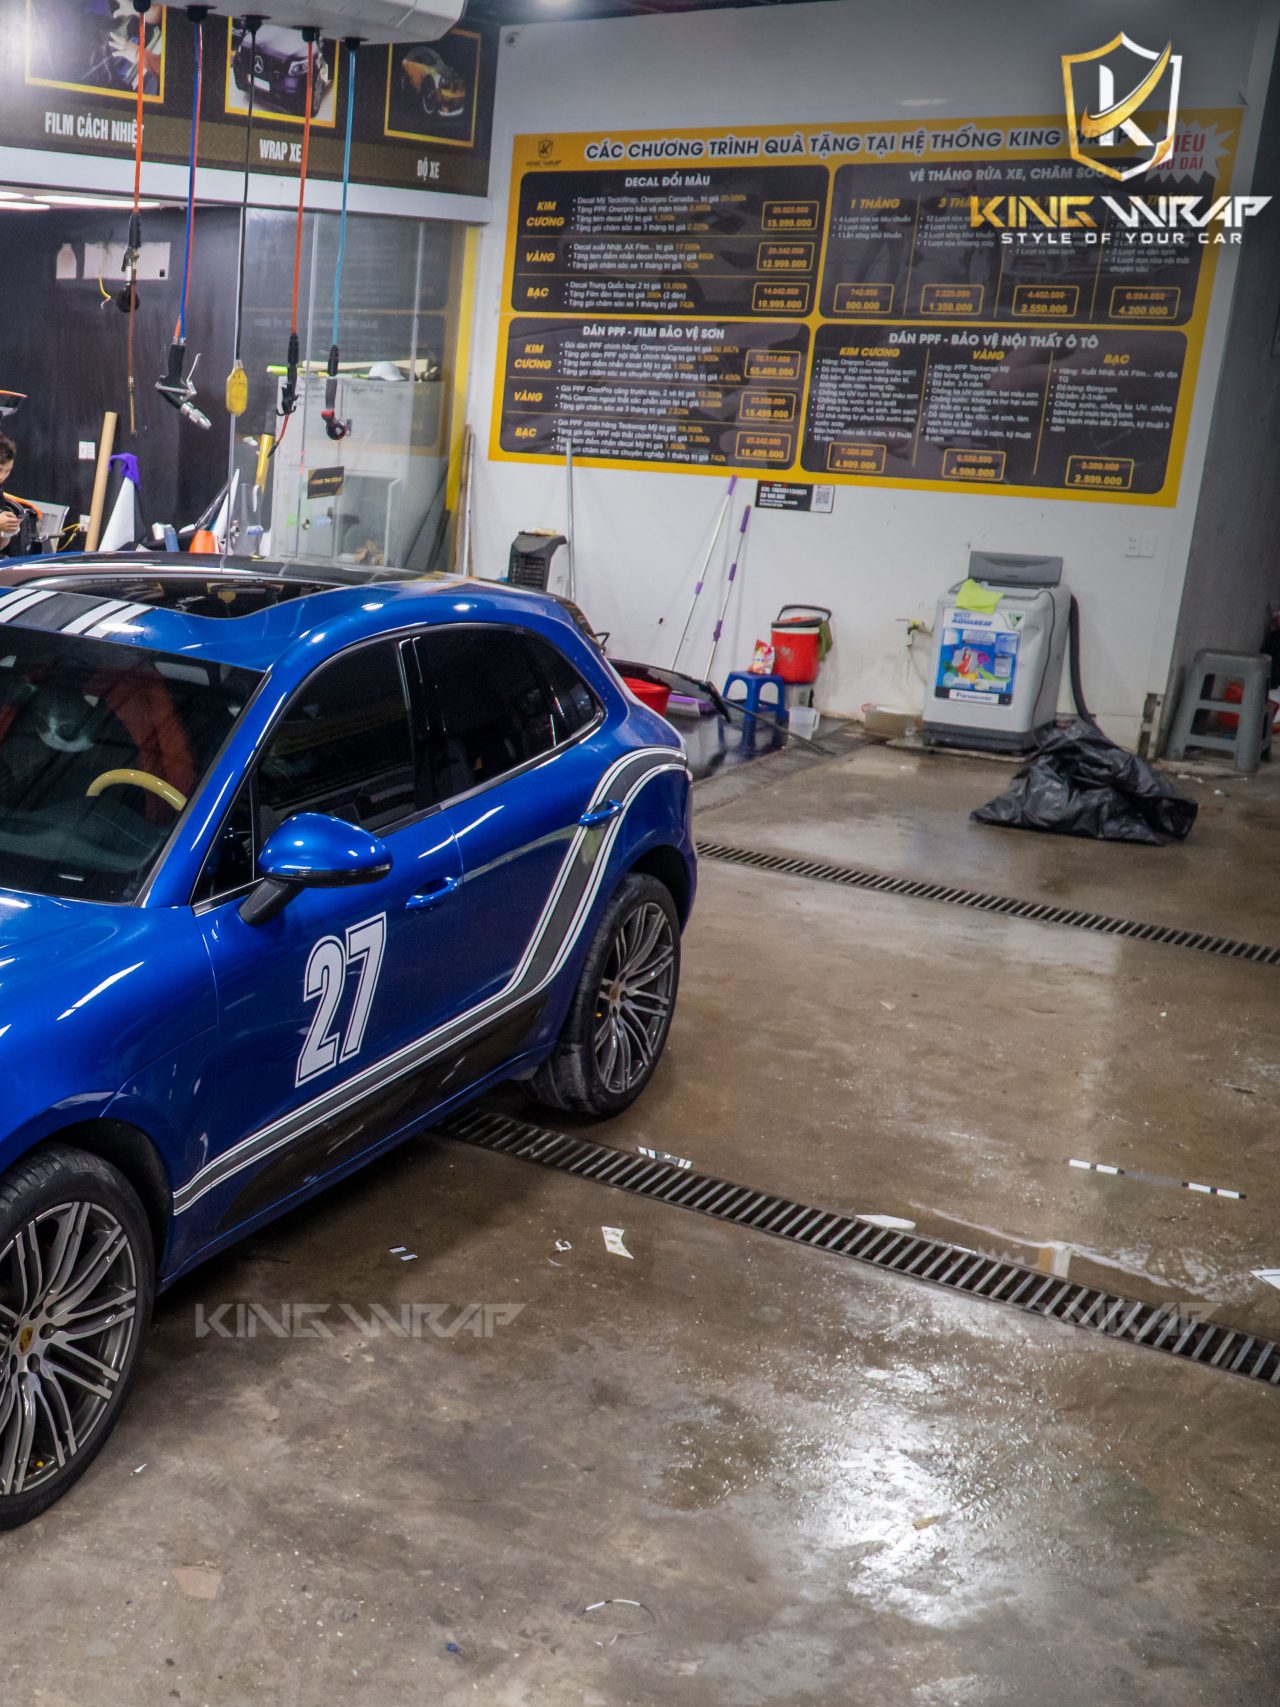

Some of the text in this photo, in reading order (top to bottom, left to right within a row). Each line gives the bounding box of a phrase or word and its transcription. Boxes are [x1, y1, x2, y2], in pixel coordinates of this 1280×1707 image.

[45, 111, 74, 137] FILM
[76, 115, 109, 141] CÁCH
[586, 140, 623, 159] CÁC
[628, 141, 703, 158] CHƯƠNG
[709, 136, 759, 155] TRÌNH
[764, 134, 804, 155] QUÀ
[810, 133, 860, 157] TẶNG
[867, 135, 895, 155] TẠI
[901, 130, 925, 154] HỆ
[931, 126, 1002, 149] THỐNG
[1009, 130, 1060, 147] KING
[1173, 131, 1206, 152] IÊU
[259, 139, 302, 163] WRAP XE
[417, 158, 440, 180] ĐỘ XE
[928, 166, 973, 181] THÁNG
[975, 166, 1002, 181] RỬA
[1030, 166, 1071, 180] CHĂM
[625, 171, 710, 187] DECAL ĐỔI MÀU
[536, 201, 557, 211] KIM
[850, 196, 901, 209] 1 THÁNG
[526, 216, 565, 227] CƯƠNG
[526, 249, 555, 262] VÀNG
[526, 287, 549, 300] BẠC
[583, 325, 605, 337] DÁN
[607, 326, 626, 337] PPF
[634, 327, 657, 337] FILM
[659, 324, 683, 338] BẢO
[685, 326, 699, 340] VỆ
[701, 327, 725, 339] SƠN
[889, 330, 916, 344] DÁN
[919, 333, 941, 345] PPF
[951, 331, 979, 346] BẢO
[983, 332, 999, 349] VỆ
[1001, 333, 1026, 348] NỘI
[1030, 331, 1063, 348] THẤT
[1065, 333, 1077, 348] Ô
[1081, 334, 1099, 348] TÔ
[524, 344, 544, 354] KIM
[839, 347, 900, 358] KIM CƯƠNG
[972, 348, 1005, 360] VÀNG
[514, 358, 552, 369] CƯƠNG
[1103, 354, 1130, 366] BẠC
[514, 390, 543, 402] VÀNG
[515, 427, 537, 439] BẠC
[294, 911, 387, 1088] 27
